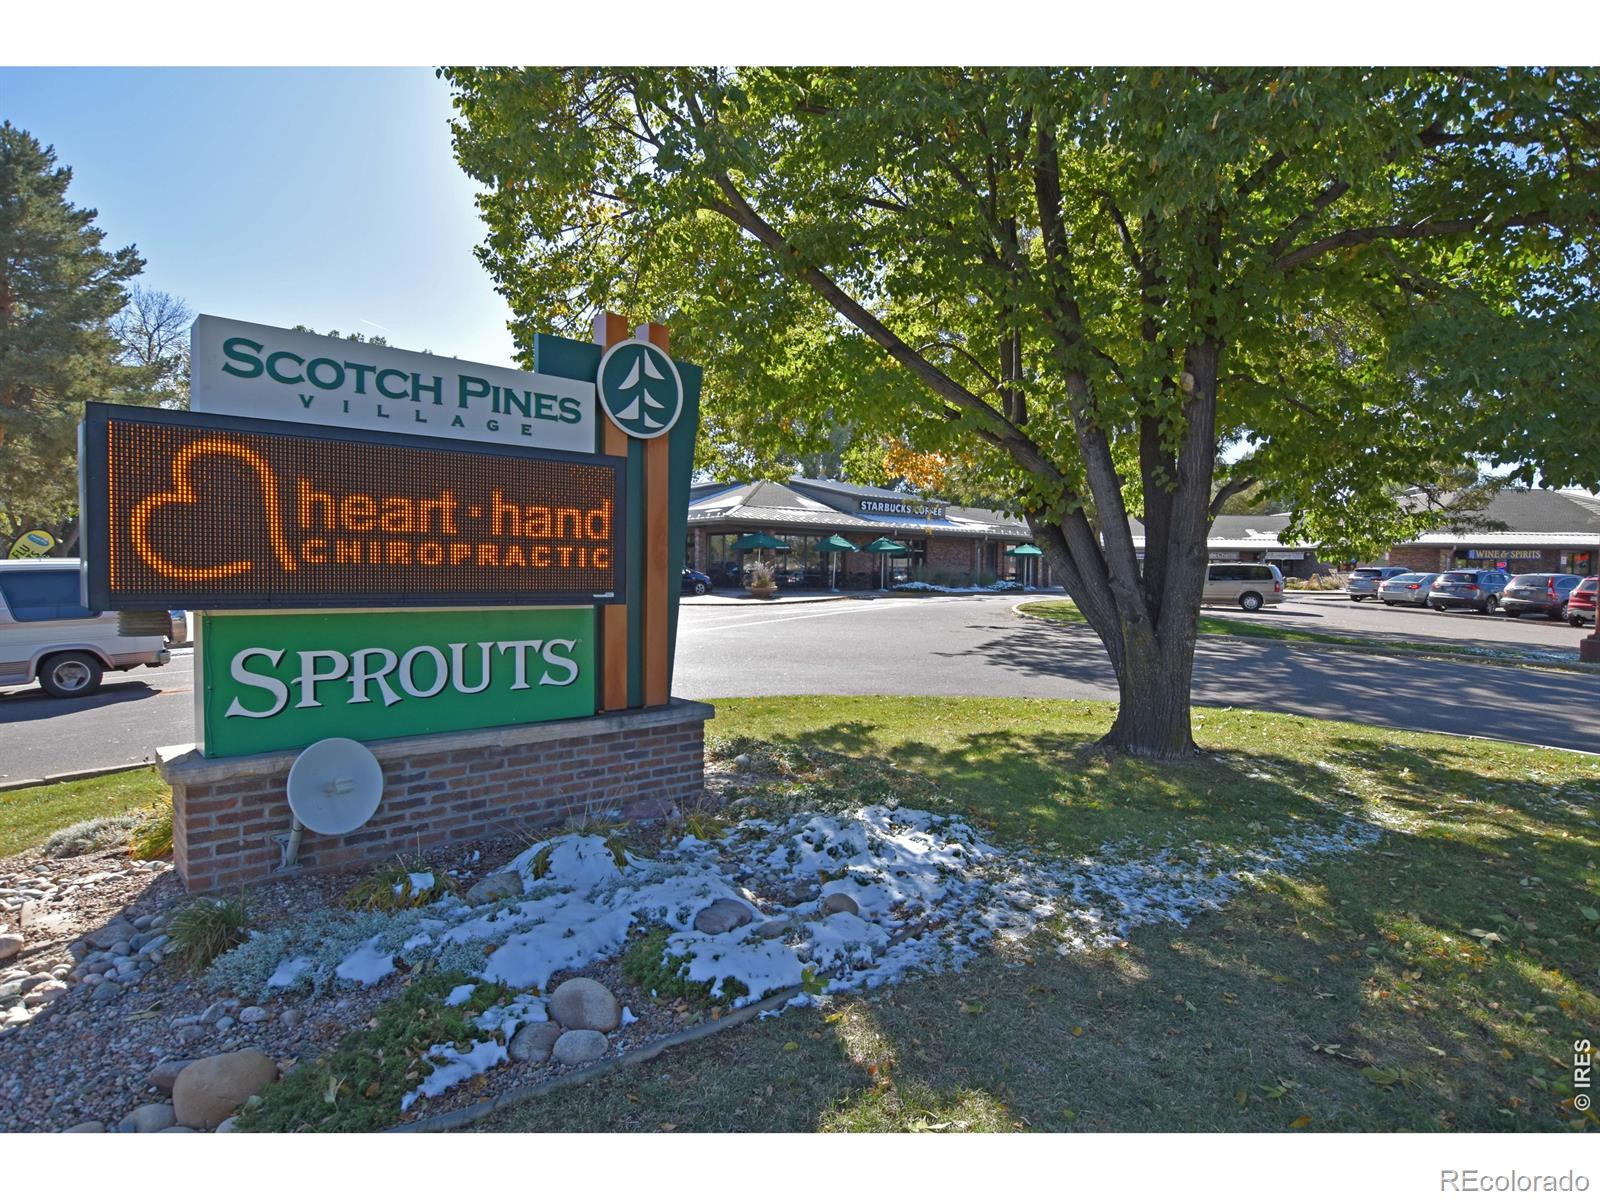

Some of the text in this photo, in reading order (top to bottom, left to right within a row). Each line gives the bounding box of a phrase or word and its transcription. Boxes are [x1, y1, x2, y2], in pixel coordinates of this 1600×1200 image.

[222, 337, 582, 424] SCOTCH PINES
[299, 394, 532, 436] VILLAGE
[298, 475, 610, 540] heart hand
[861, 501, 912, 514] STARBUCKS
[302, 538, 609, 568] CHIROPRACTIC
[1475, 550, 1500, 559] WINE
[1510, 550, 1541, 559] SPIRITS
[224, 638, 579, 719] SPROUTS
